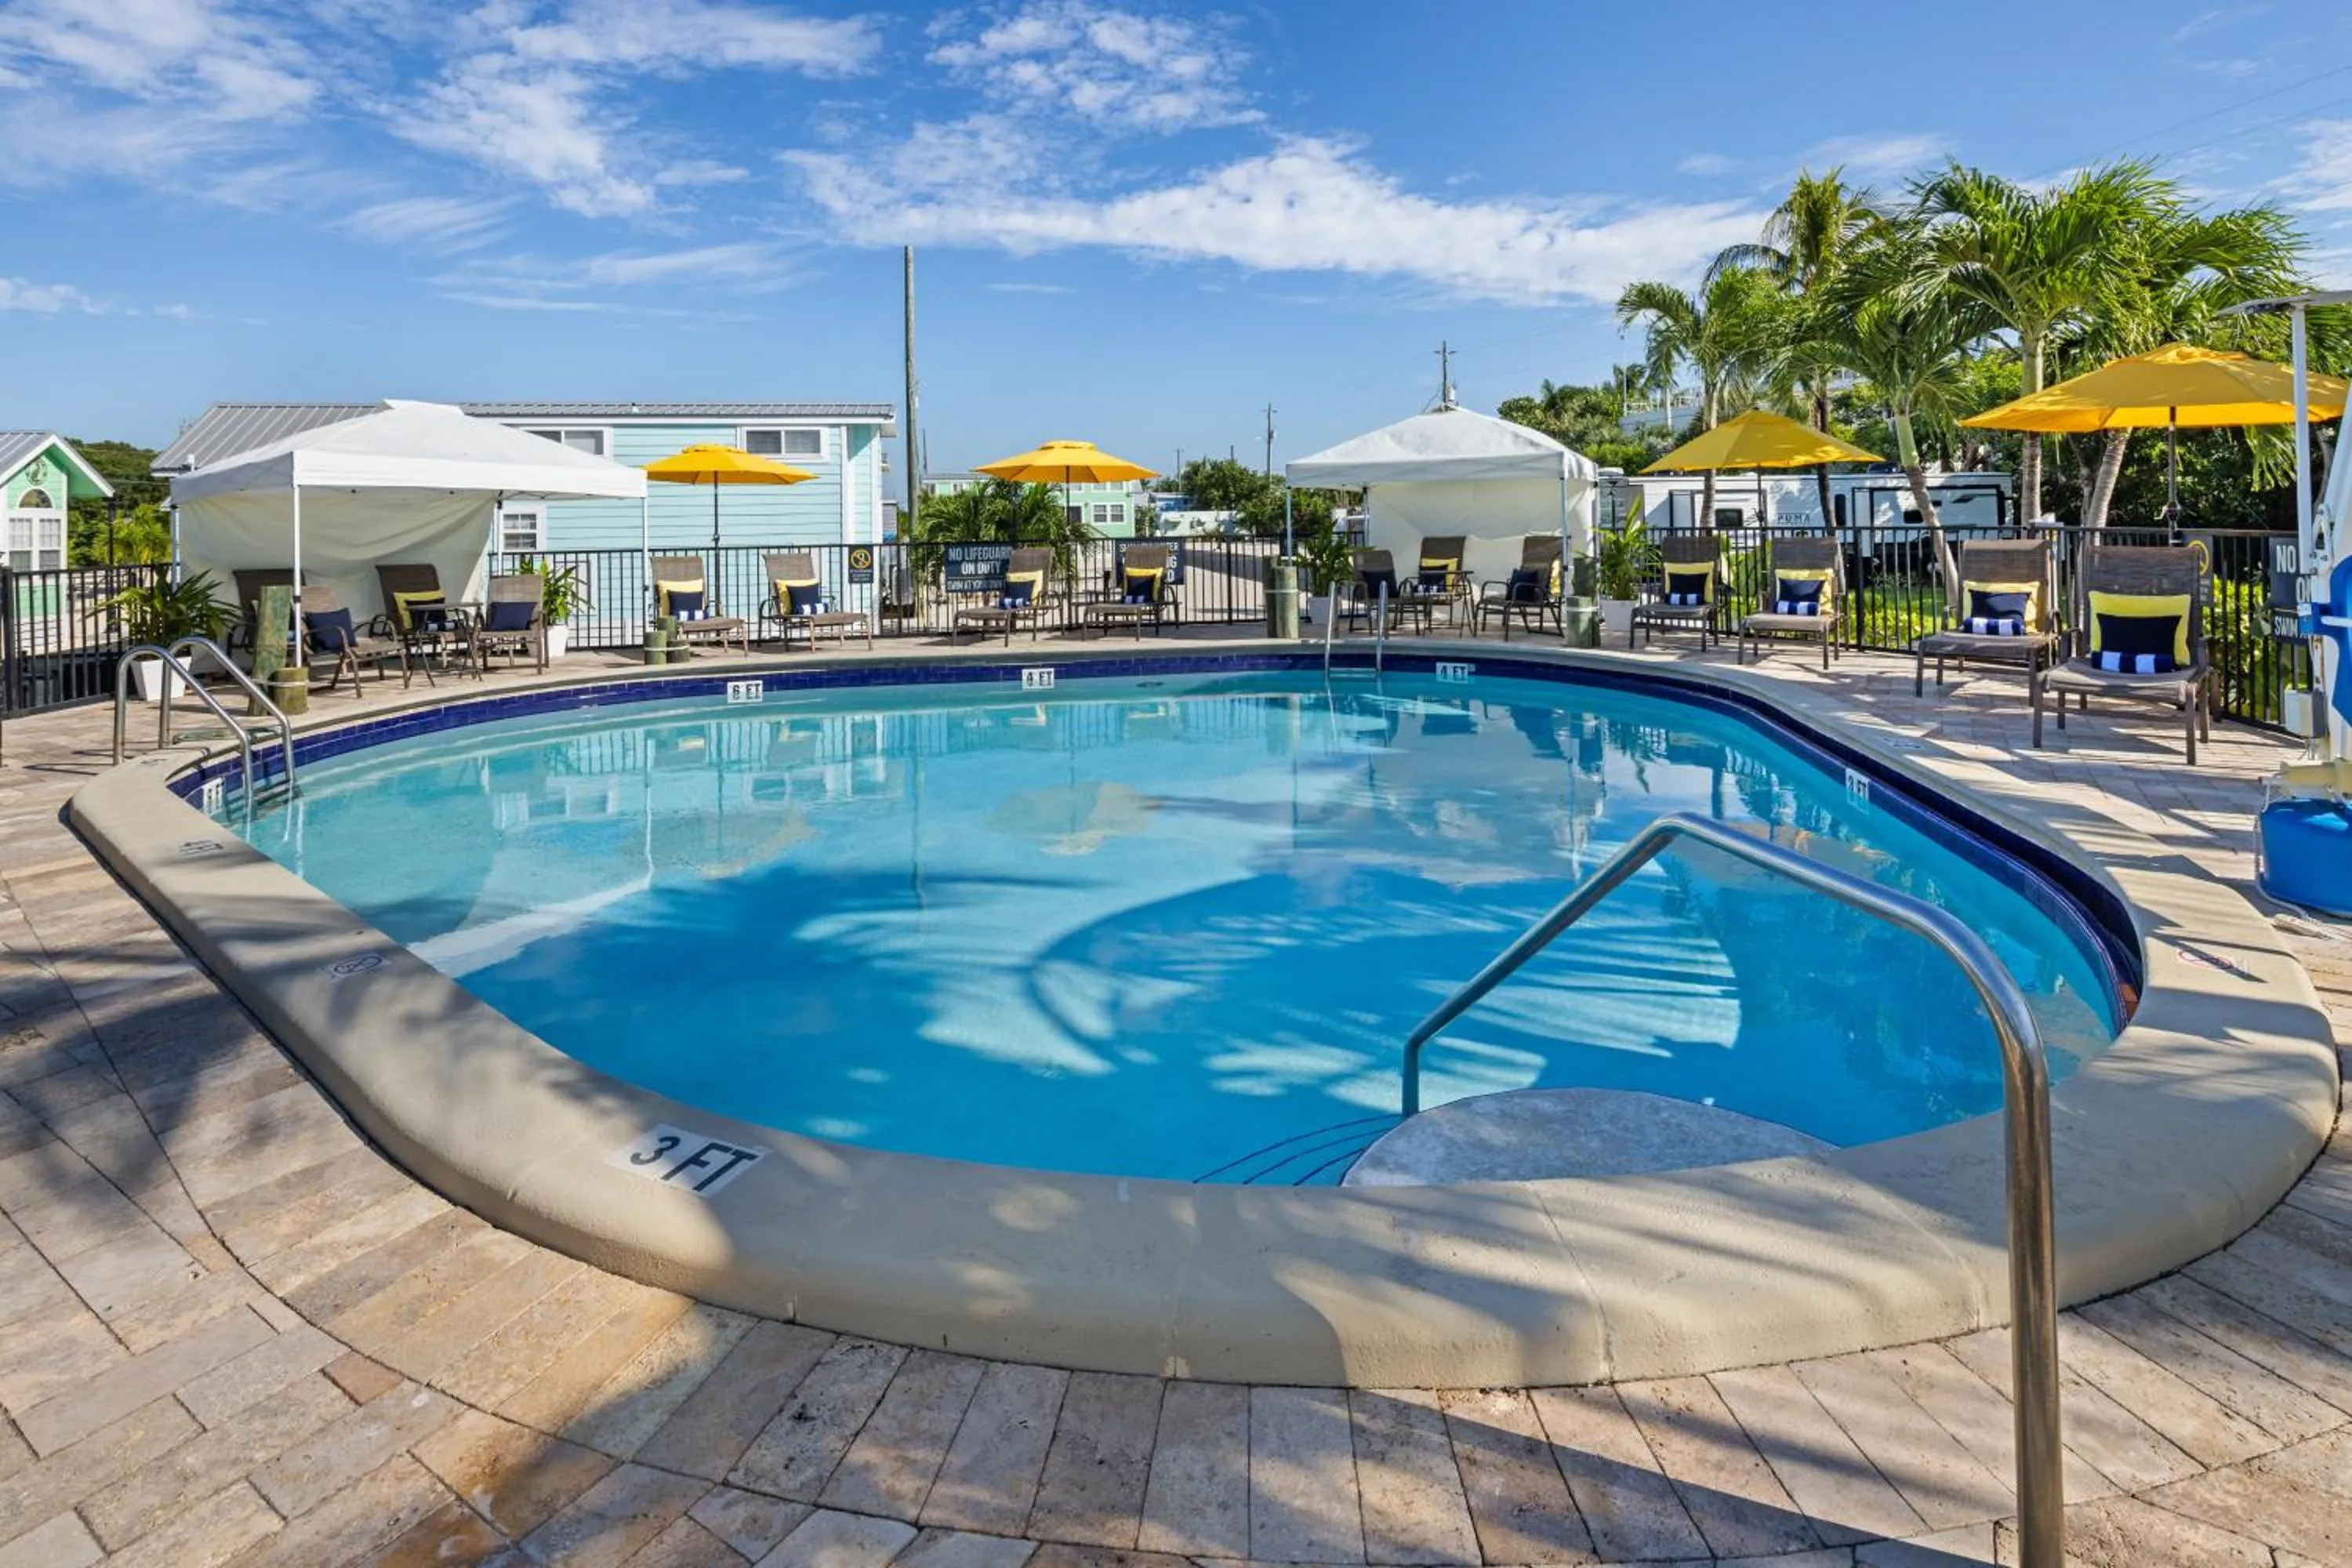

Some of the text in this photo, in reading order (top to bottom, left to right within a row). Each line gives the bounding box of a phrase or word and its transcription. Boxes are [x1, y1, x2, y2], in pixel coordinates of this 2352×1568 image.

[1777, 514, 1810, 524] PUMA
[949, 548, 963, 561] NO
[2276, 545, 2296, 573] NO
[961, 561, 1000, 575] ON DUTY
[2274, 616, 2298, 637] SWIM
[630, 1136, 759, 1192] 3 FT
